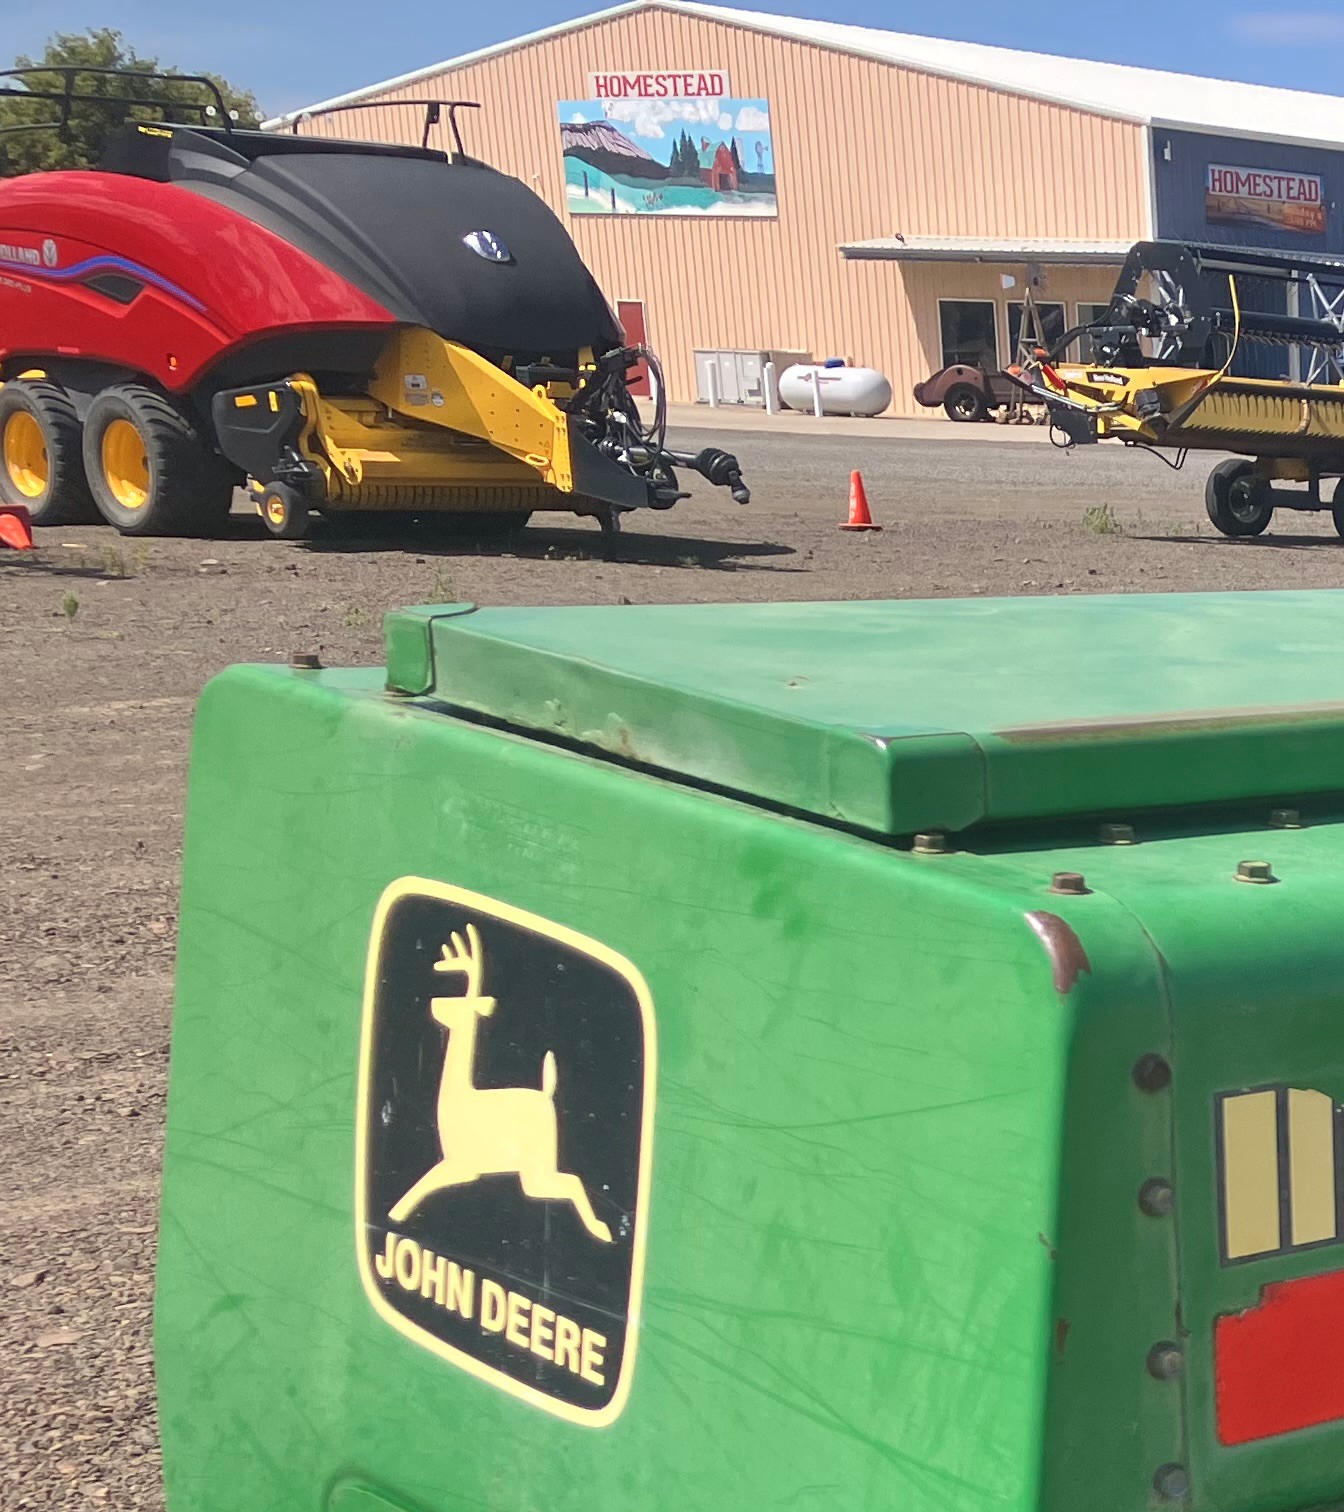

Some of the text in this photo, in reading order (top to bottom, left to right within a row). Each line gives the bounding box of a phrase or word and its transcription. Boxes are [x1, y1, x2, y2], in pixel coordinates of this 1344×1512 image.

[594, 74, 724, 98] HOMESTEAD
[1210, 168, 1320, 202] HOMESTEAD
[375, 1231, 608, 1386] JOHN DEERE
